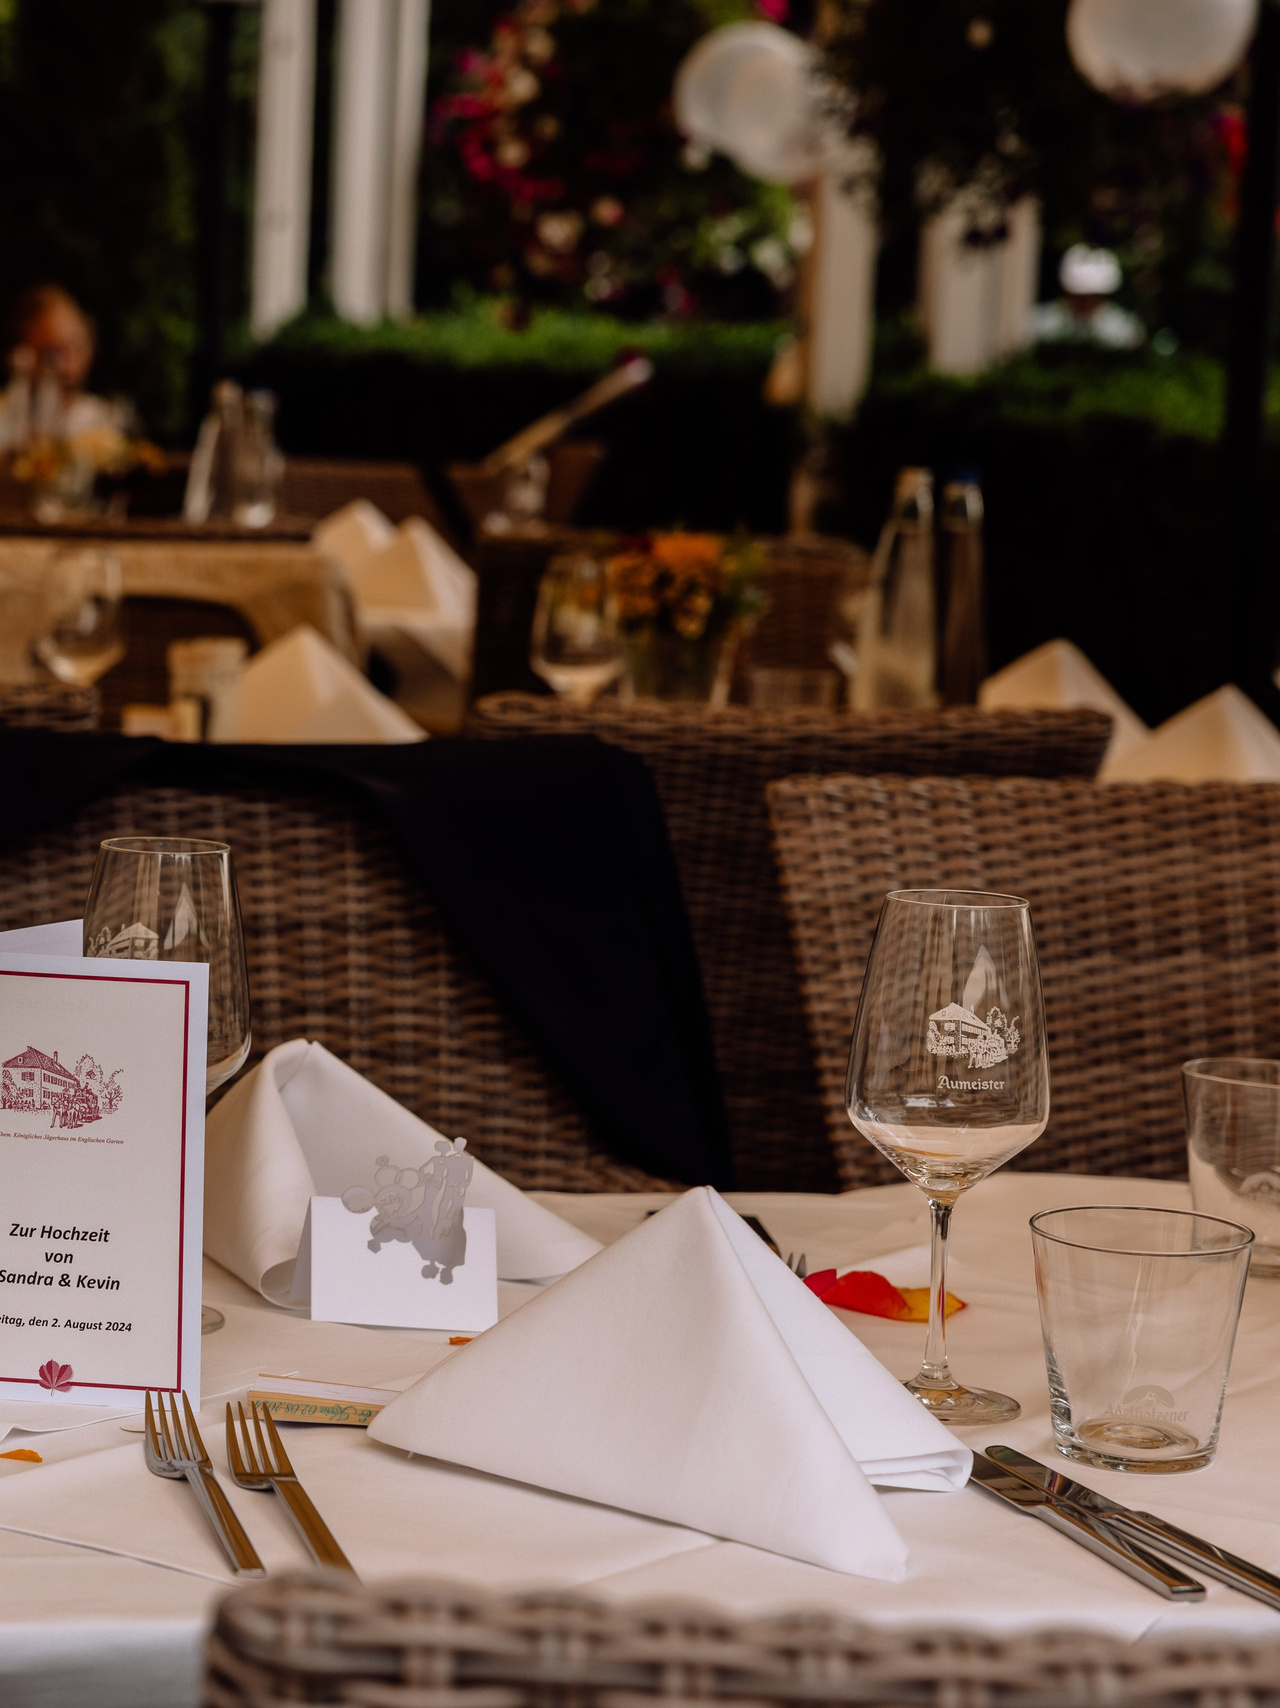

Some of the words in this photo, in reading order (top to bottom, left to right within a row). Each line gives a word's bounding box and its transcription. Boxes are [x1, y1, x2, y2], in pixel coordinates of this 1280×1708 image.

[937, 1075, 1005, 1091] Aumeister
[13, 1132, 43, 1140] Königliches
[43, 1134, 69, 1142] Jägerhaus
[77, 1136, 106, 1144] Englischen
[9, 1223, 37, 1238] Zur
[40, 1225, 110, 1243] Hochzeit
[44, 1252, 74, 1264] von
[58, 1273, 71, 1288] &
[76, 1274, 120, 1291] Kevin
[28, 1316, 49, 1327] den
[51, 1318, 61, 1328] 2.
[64, 1319, 103, 1331] August
[105, 1321, 133, 1332] 2024
[1104, 1402, 1190, 1422] Adelholzener
